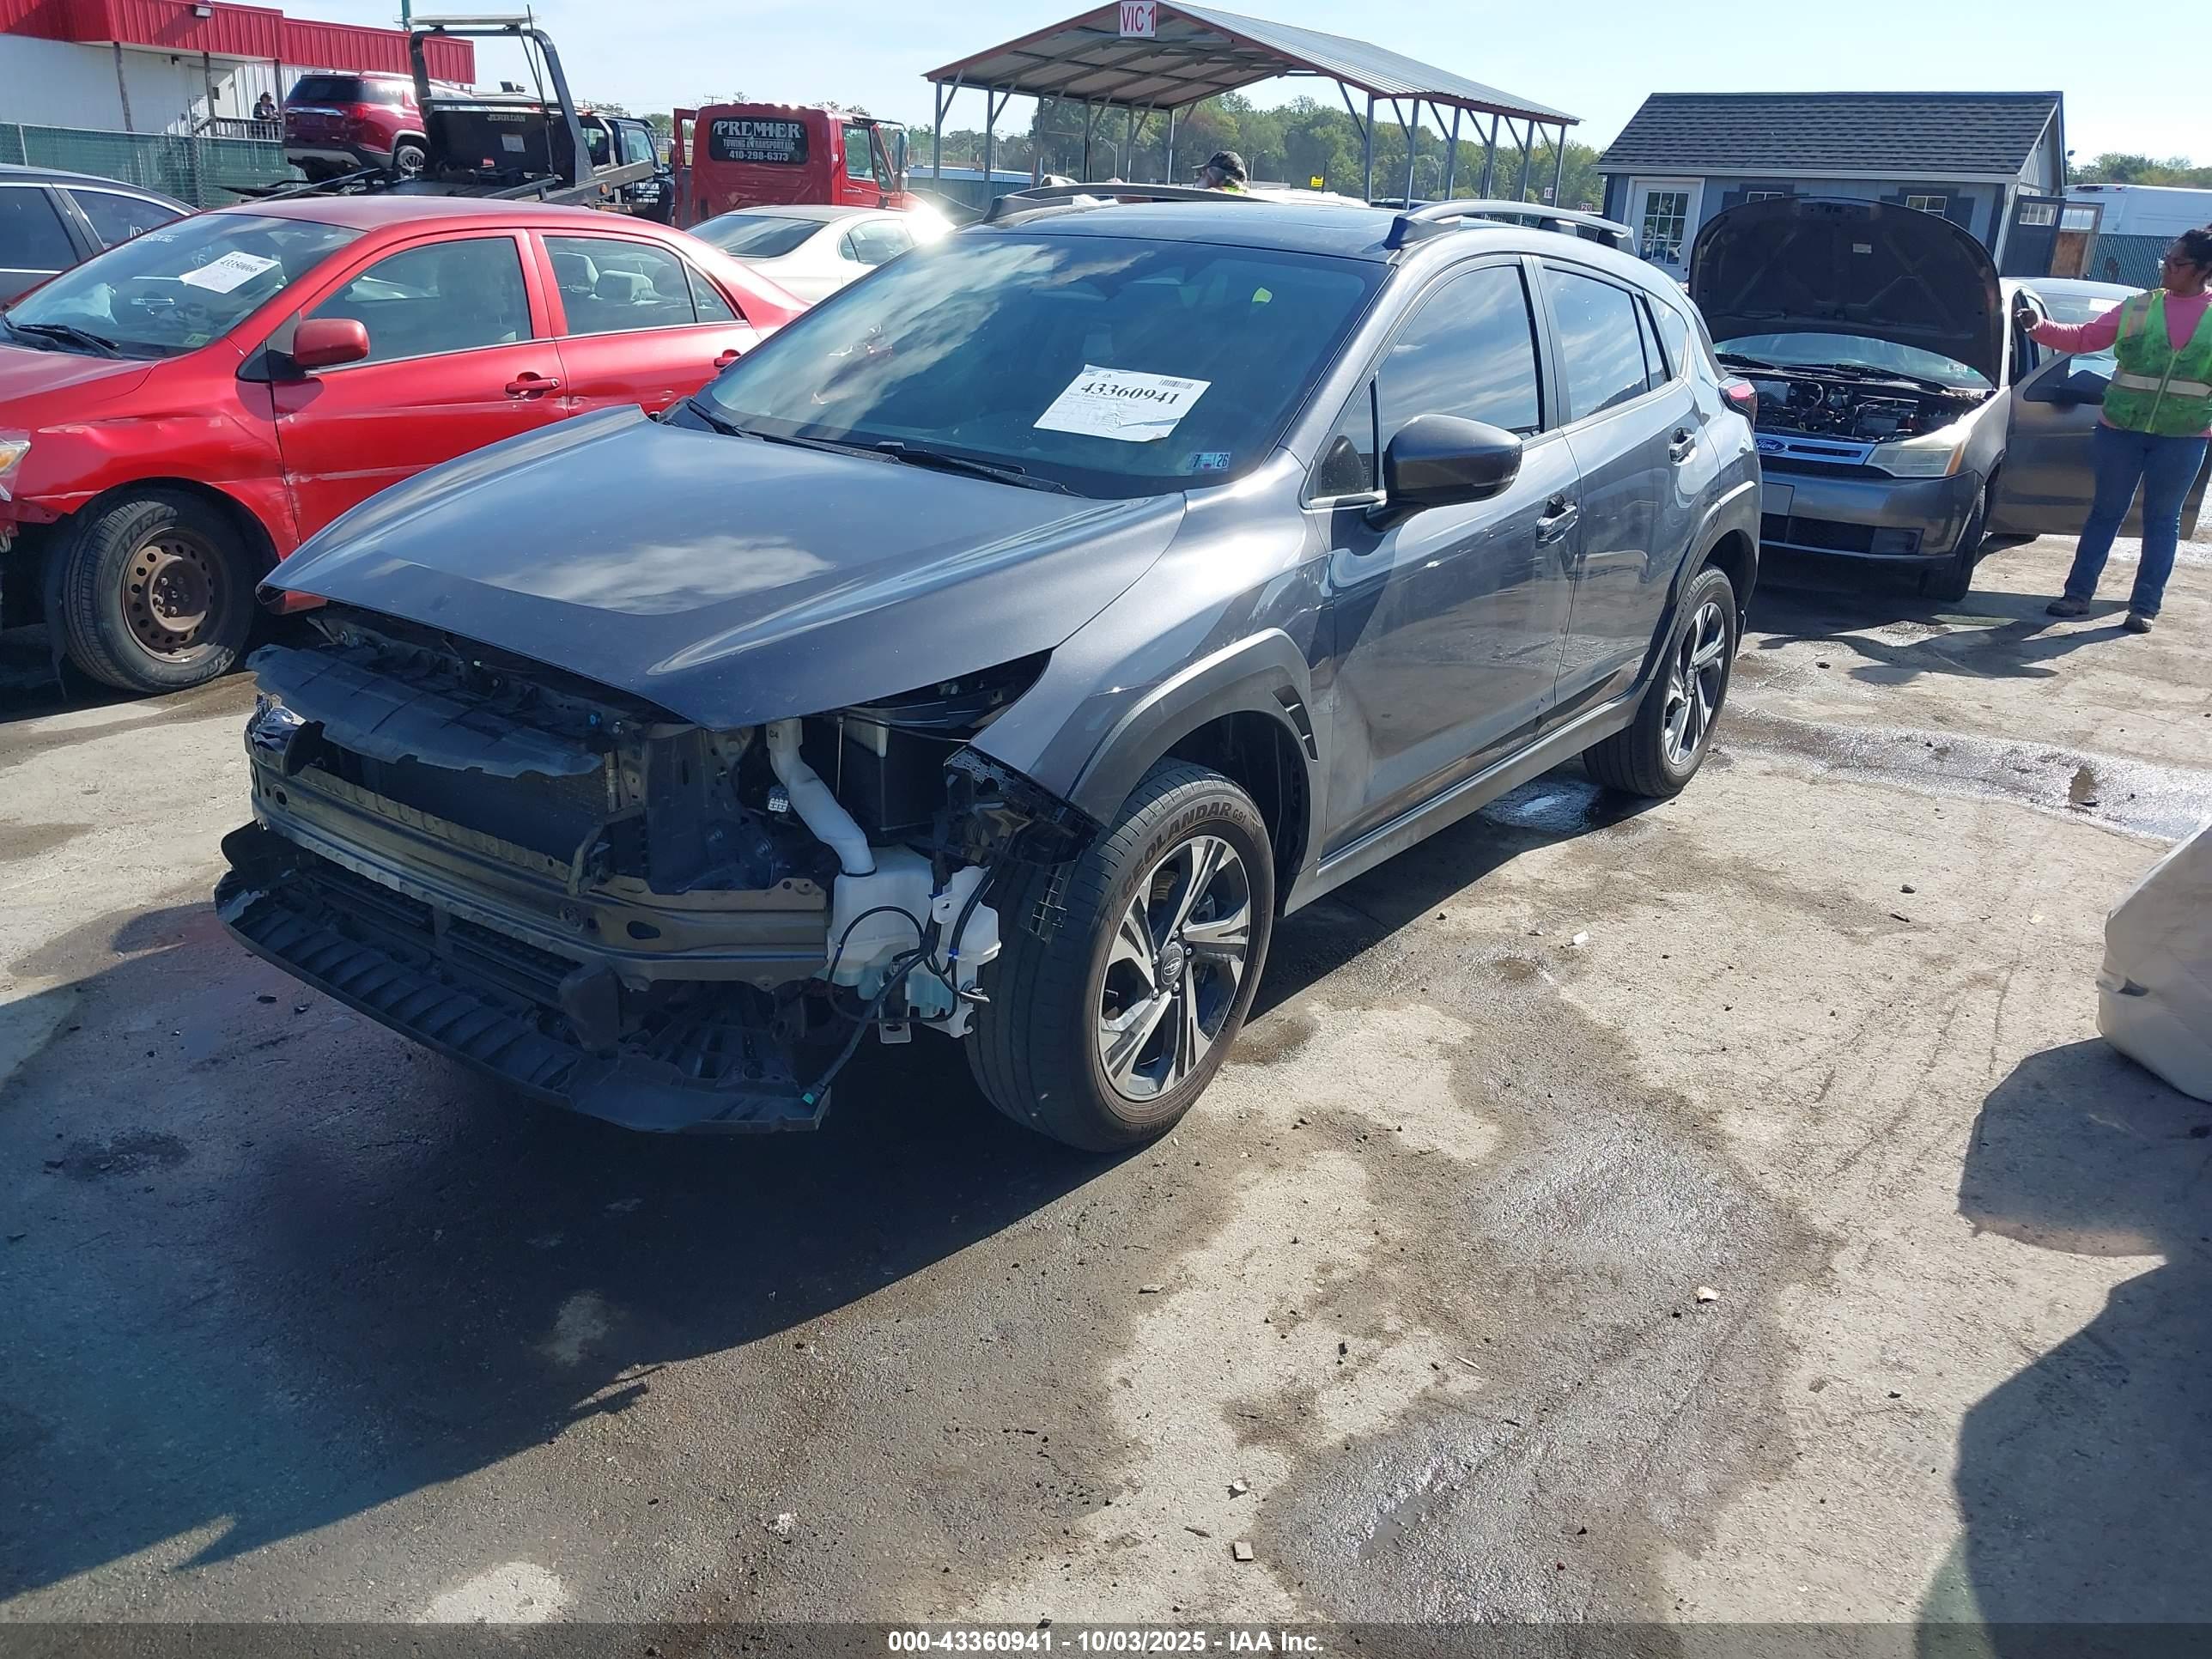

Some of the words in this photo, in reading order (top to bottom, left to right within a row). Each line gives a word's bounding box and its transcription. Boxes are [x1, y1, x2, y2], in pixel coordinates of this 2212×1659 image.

[1121, 5, 1145, 32] VIC
[1147, 6, 1155, 32] 1
[713, 120, 801, 138] PREMIER
[723, 138, 746, 149] TOWING
[729, 149, 789, 161] 410-298-6373
[1582, 203, 1593, 211] 20
[1080, 381, 1180, 404] 43360941
[1757, 439, 1778, 450] Ford
[1217, 453, 1229, 467] 26
[1121, 801, 1232, 899] GEOLANDAR
[1232, 809, 1247, 825] G91
